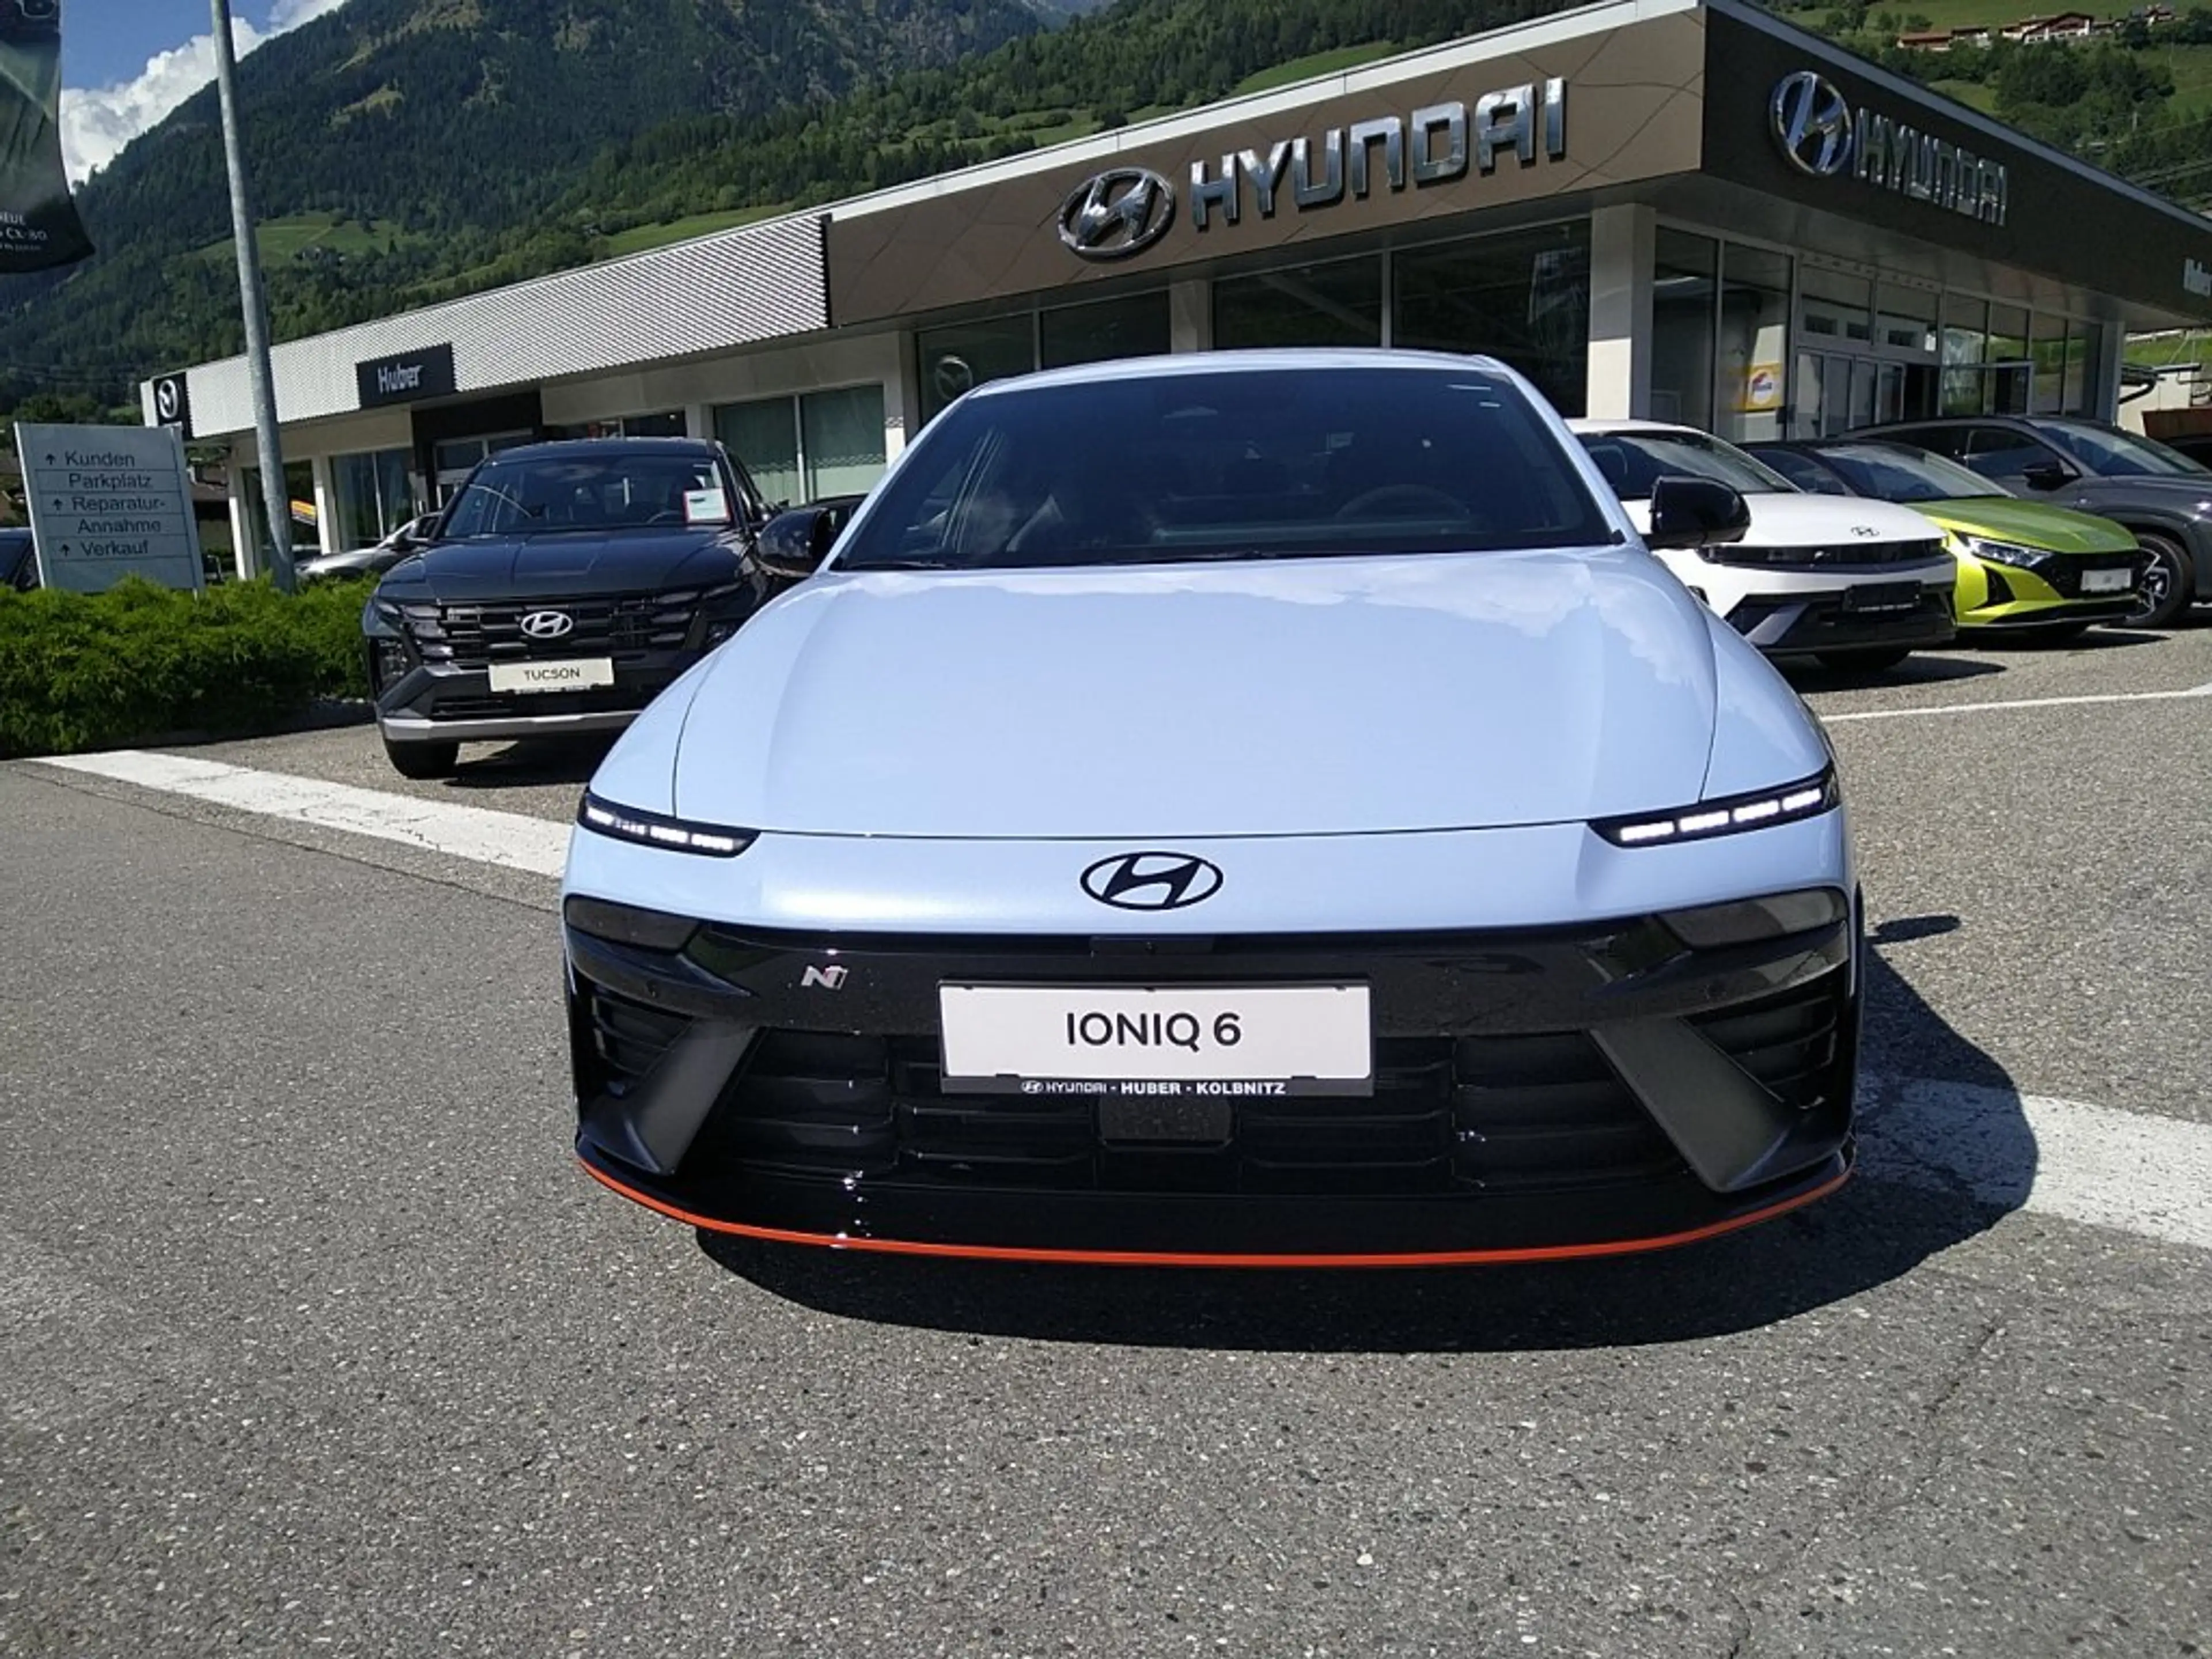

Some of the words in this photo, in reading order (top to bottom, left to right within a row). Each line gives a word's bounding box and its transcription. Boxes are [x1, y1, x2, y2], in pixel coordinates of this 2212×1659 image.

[1190, 77, 1566, 228] HYUNDAI
[1853, 108, 2008, 226] HYUNDAI
[377, 363, 425, 393] Huber
[65, 450, 135, 468] Kunden
[69, 472, 154, 491] Parkplatz
[72, 496, 166, 514] Reparatur-
[77, 518, 161, 534] Annahme
[80, 540, 149, 556] Verkauf
[524, 666, 581, 681] TUCSON
[1066, 1012, 1201, 1052] IONIQ
[1213, 1012, 1243, 1047] 6
[1046, 1081, 1107, 1093] HYUNDAI
[1120, 1081, 1181, 1094] HUBER
[1196, 1081, 1286, 1094] KOLBNITZ
